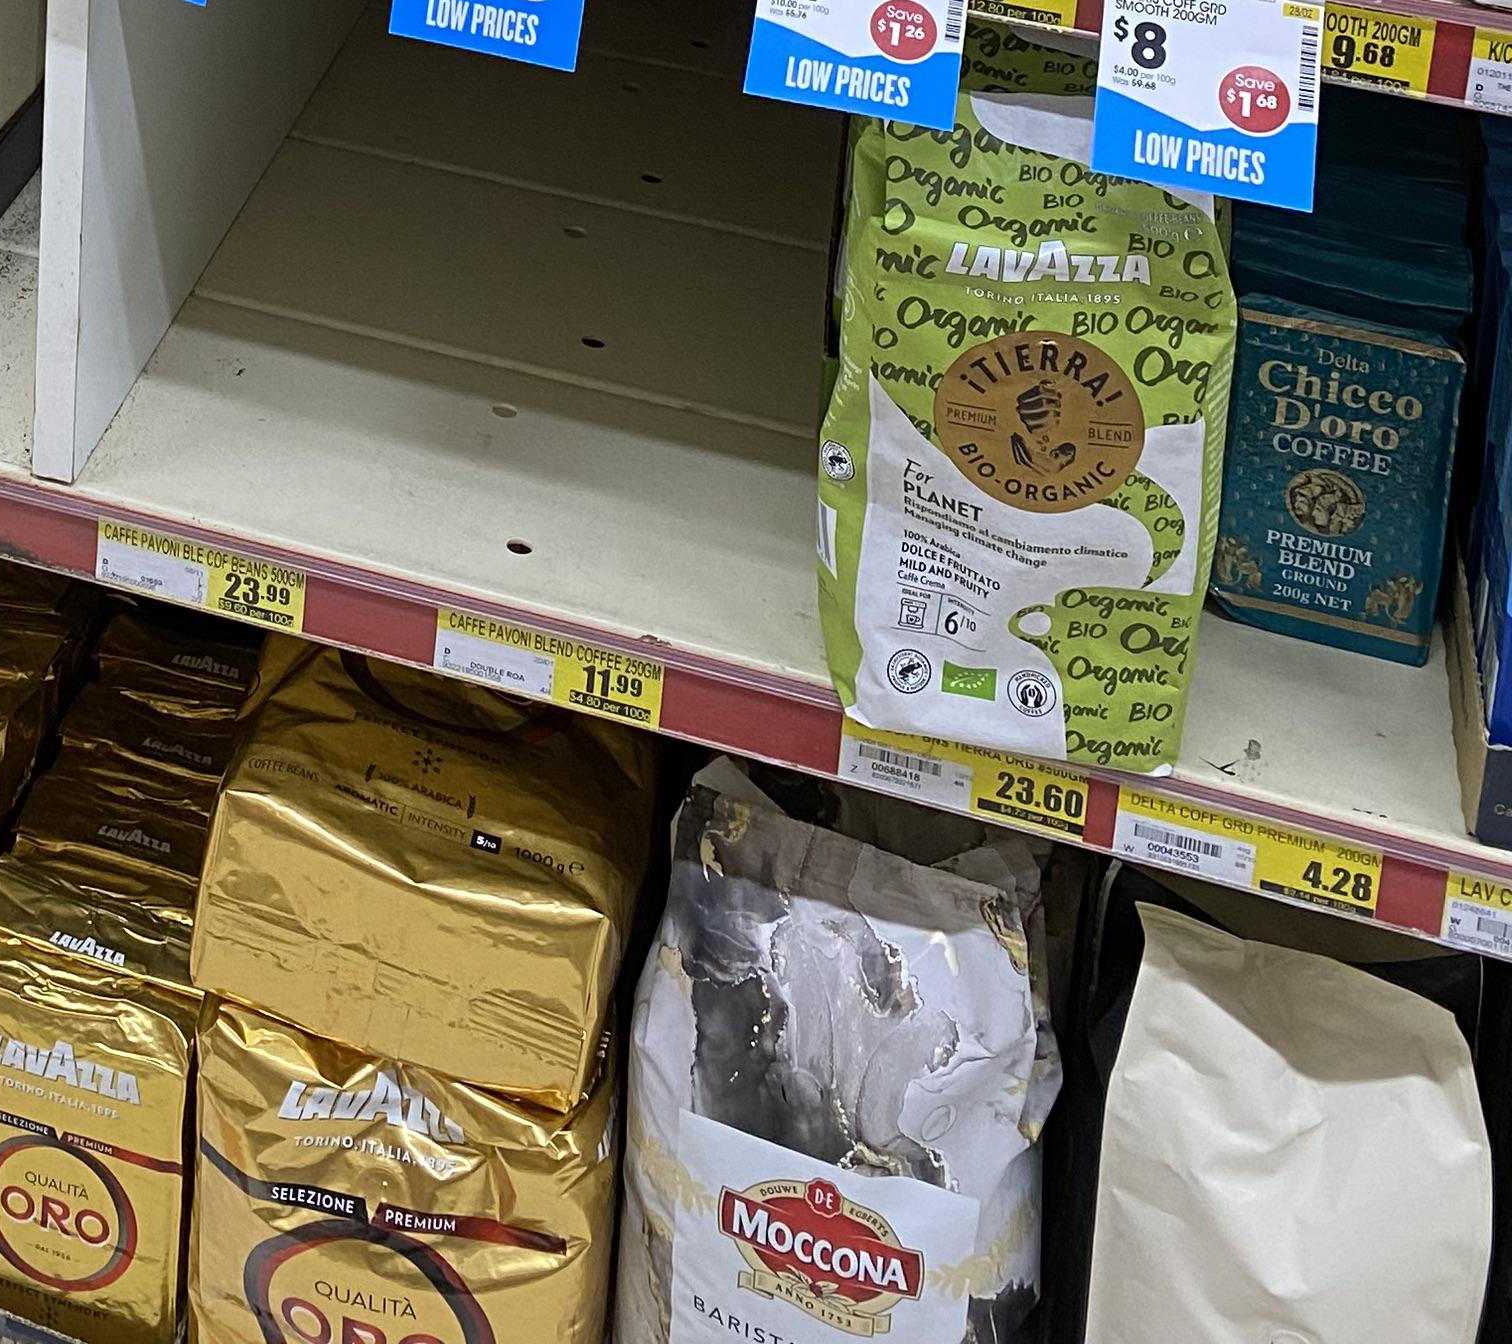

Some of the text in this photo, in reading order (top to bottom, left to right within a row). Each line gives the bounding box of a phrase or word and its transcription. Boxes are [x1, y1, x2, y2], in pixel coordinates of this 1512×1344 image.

[1113, 15, 1167, 70] $8
[1332, 35, 1396, 69] 9.68
[784, 56, 911, 108] LOW PRICES
[945, 240, 1152, 287] LAVAZZA
[1317, 349, 1370, 374] Delta
[1258, 360, 1424, 422] Chicco
[1272, 433, 1393, 476] COFFEE
[903, 481, 984, 523] PLANET
[1266, 529, 1372, 568] PREMIUM
[1277, 548, 1356, 580] BLEND
[225, 573, 290, 605] 23.99
[1272, 582, 1352, 612] 200g NET
[449, 612, 662, 681] CAFFE PAVONI BLEND COFFEE 250GM
[582, 665, 643, 698] 11.99
[1130, 791, 1327, 855] DELTA COFF GRD PREMIUM
[1301, 860, 1373, 903] 4.28
[0, 1185, 111, 1247] ORO
[271, 1186, 457, 1233] SELEZIONE PREMIUM
[731, 1198, 908, 1293] MOCCONA
